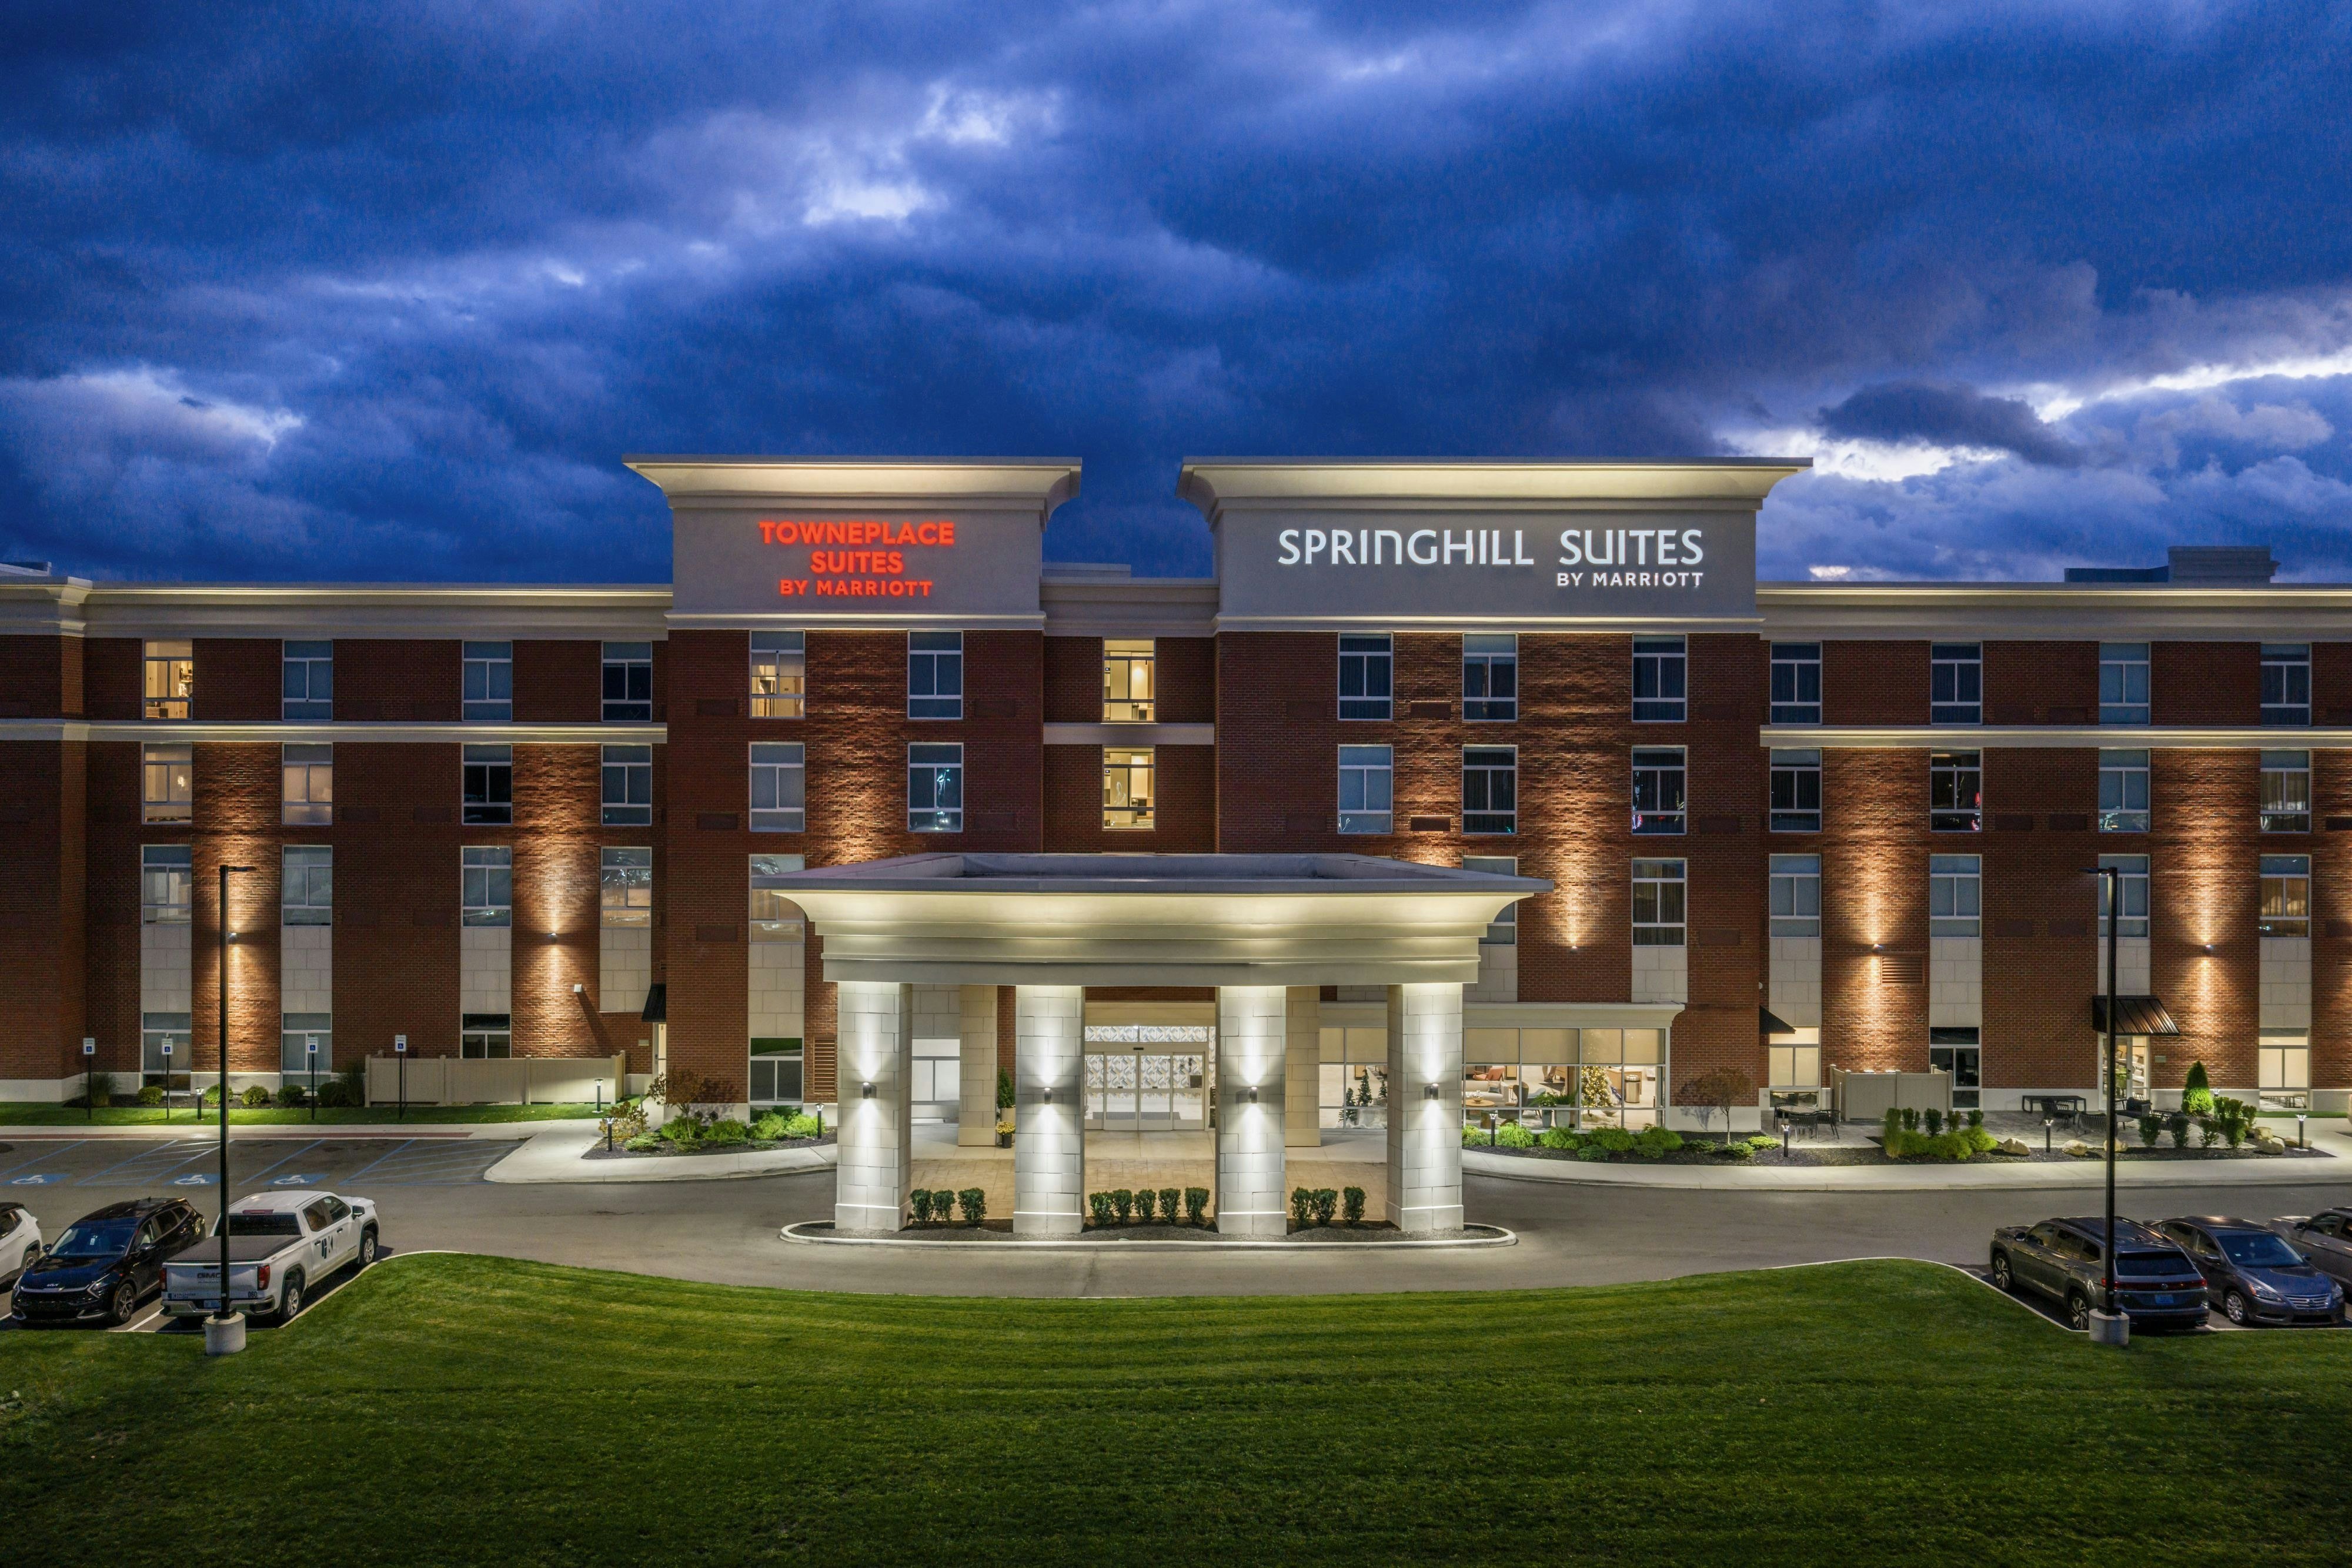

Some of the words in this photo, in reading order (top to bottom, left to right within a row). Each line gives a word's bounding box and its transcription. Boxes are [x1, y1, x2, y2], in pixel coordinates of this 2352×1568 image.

[759, 521, 954, 545] TOWNEPLACE
[1278, 529, 1535, 565] SPRINGHILL
[1559, 529, 1703, 565] SUITES
[811, 550, 904, 574] SUITES
[780, 580, 808, 596] BY
[817, 580, 932, 596] MARRIOTT
[1558, 572, 1583, 586] BY
[1593, 572, 1703, 587] MARRIOTT
